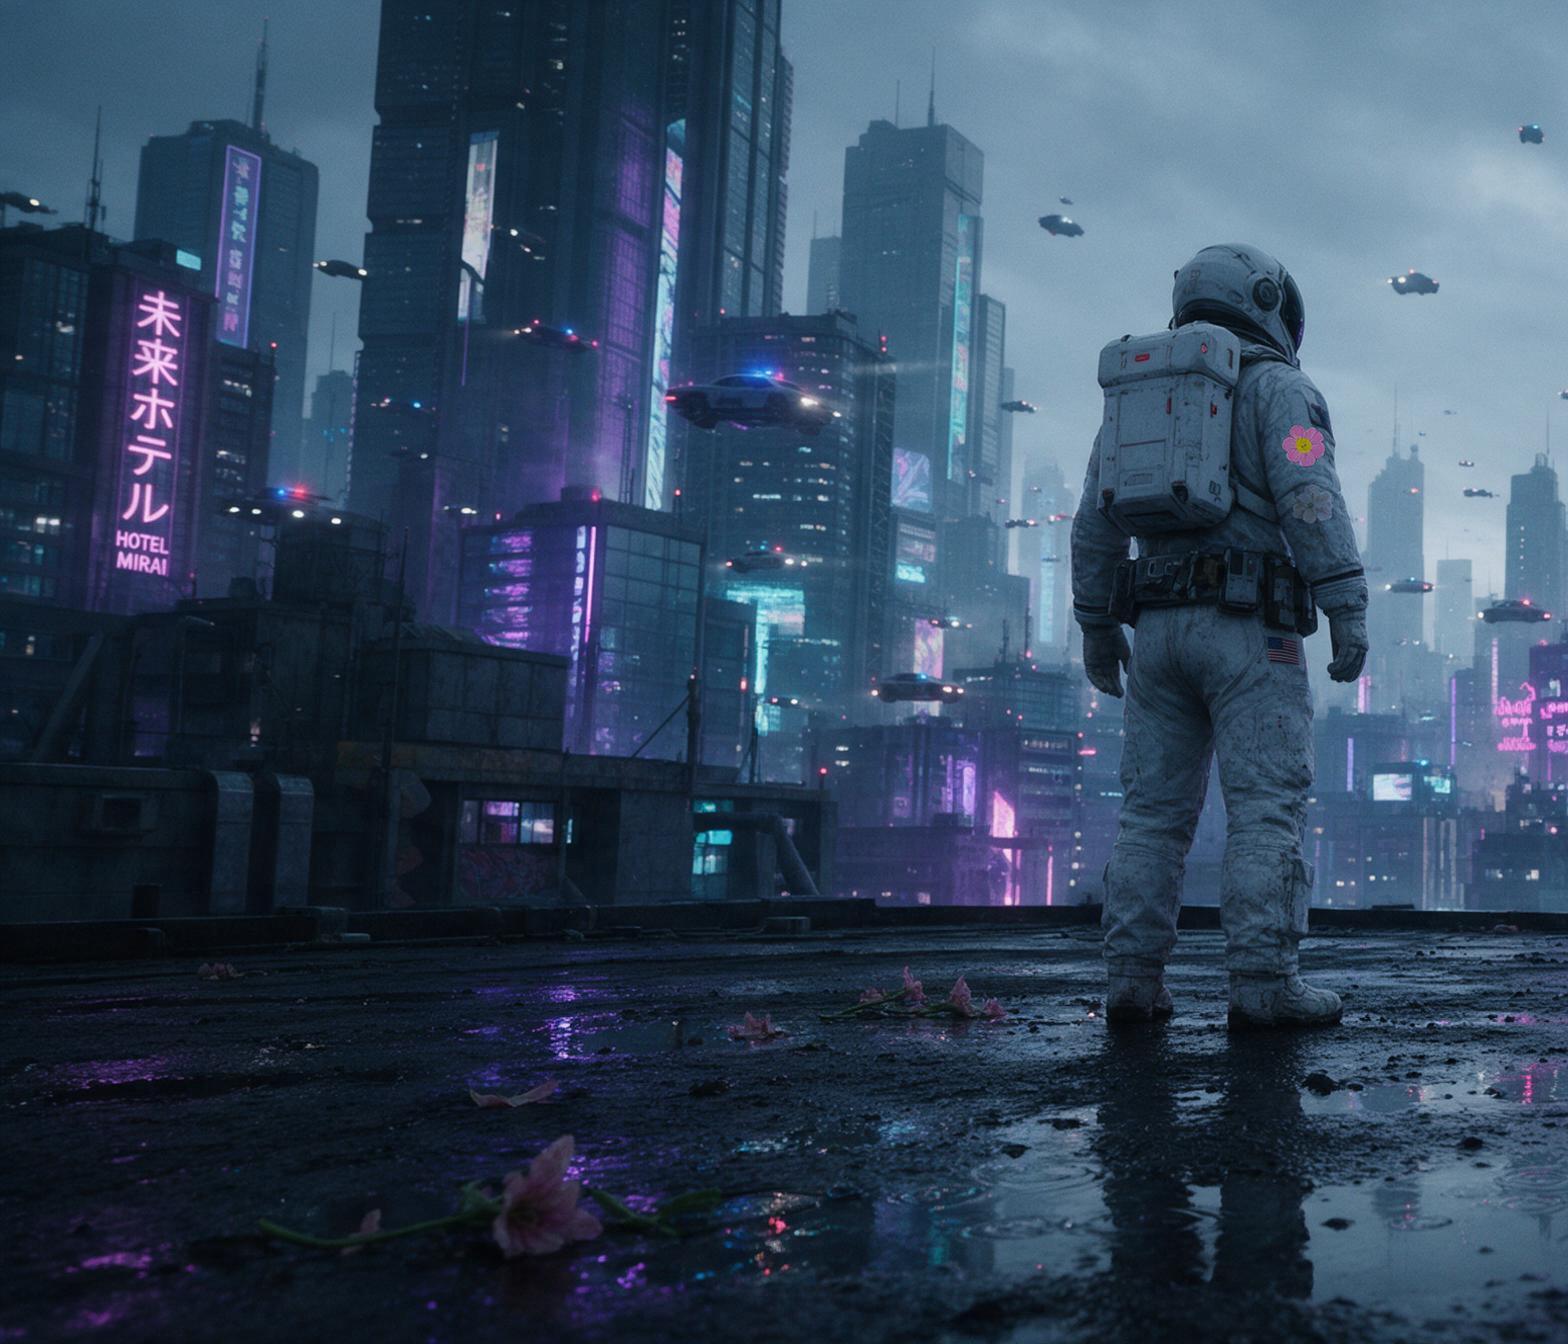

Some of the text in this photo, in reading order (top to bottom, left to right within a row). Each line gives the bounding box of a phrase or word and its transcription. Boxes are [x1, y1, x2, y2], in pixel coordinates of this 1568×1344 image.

[122, 290, 182, 524] 未来ホテル
[115, 529, 169, 555] HOTEL
[116, 551, 168, 576] MIRAI
